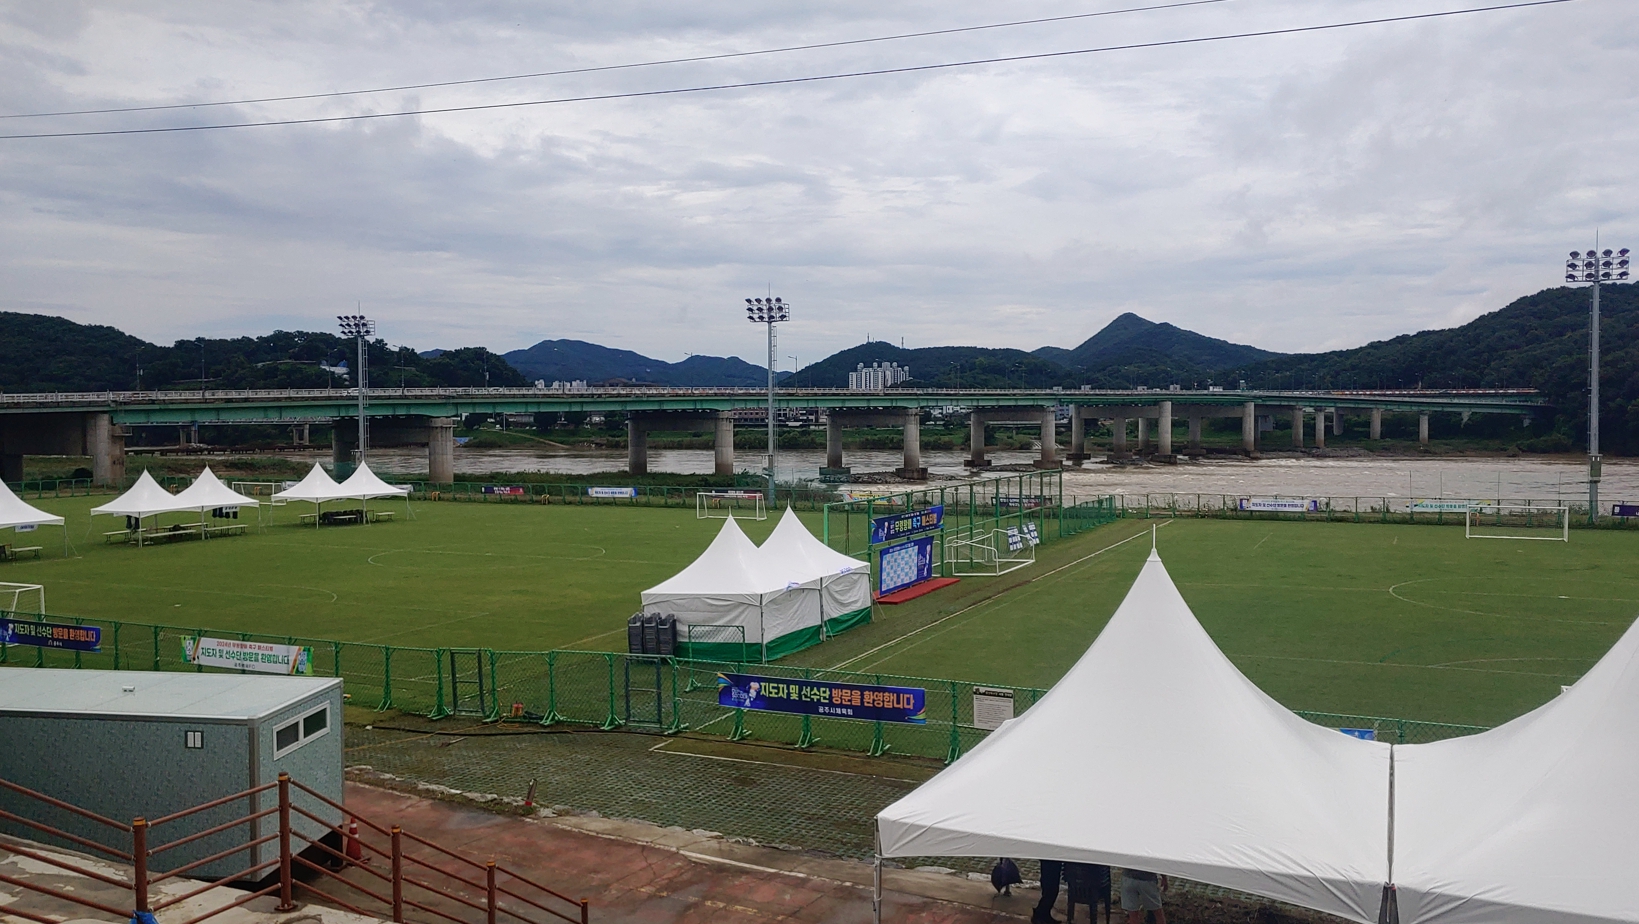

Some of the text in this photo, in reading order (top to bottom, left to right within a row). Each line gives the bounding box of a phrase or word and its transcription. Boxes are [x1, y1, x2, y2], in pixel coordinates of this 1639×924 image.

[912, 516, 921, 529] 축구
[14, 623, 96, 642] 지도자 및 선수단 방문을 환영합니다
[200, 646, 217, 658] 지도자
[218, 649, 224, 659] 및
[225, 649, 242, 661] 선수단
[242, 651, 260, 662] 방문을
[760, 682, 788, 699] 지도자
[790, 684, 799, 700] 및
[801, 686, 830, 704] 선수단
[832, 688, 861, 706] 방문을
[863, 690, 914, 710] 환영합니다
[818, 705, 854, 716] 공주시체육회
